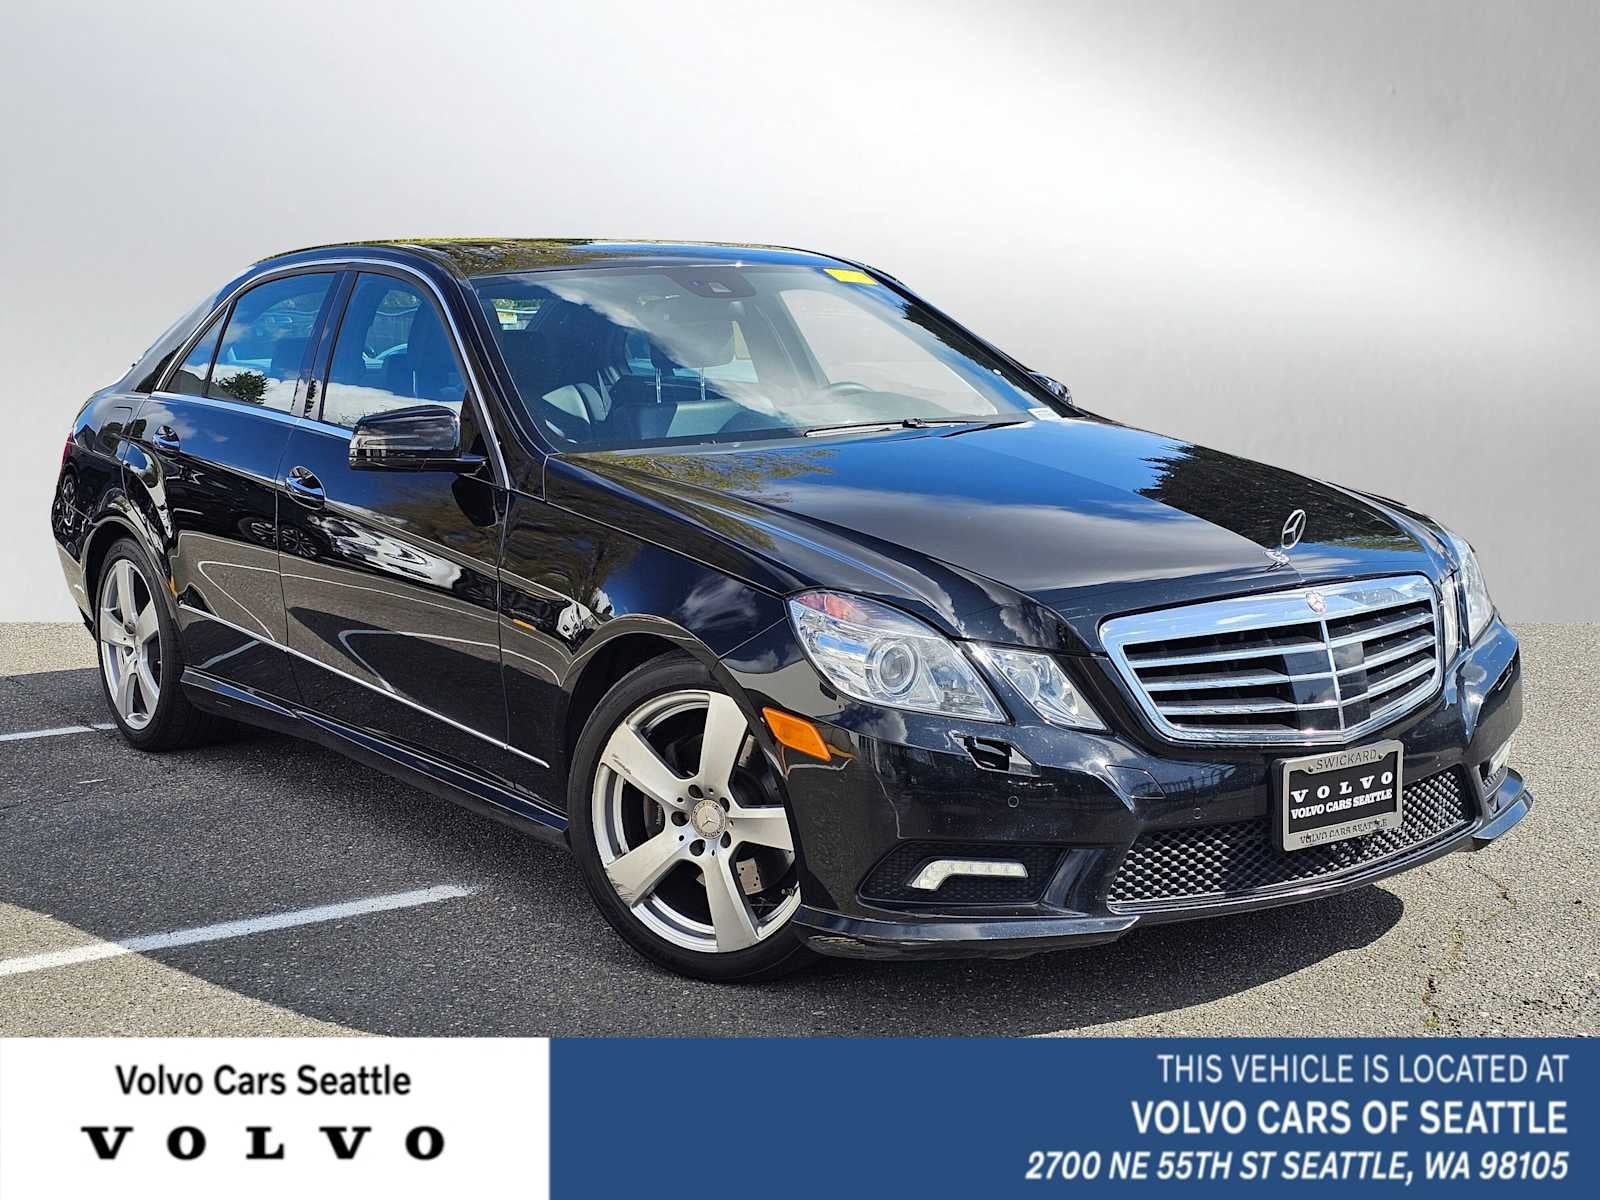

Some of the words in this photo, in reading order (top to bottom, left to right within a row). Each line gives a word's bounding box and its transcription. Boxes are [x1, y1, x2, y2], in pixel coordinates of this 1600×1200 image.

[1316, 749, 1377, 770] SWICKARD
[1291, 772, 1393, 803] VOLVO
[1291, 804, 1325, 819] VOLVO
[1326, 798, 1352, 812] CARS
[1353, 789, 1393, 807] SEATTLE
[1329, 826, 1351, 838] CARS
